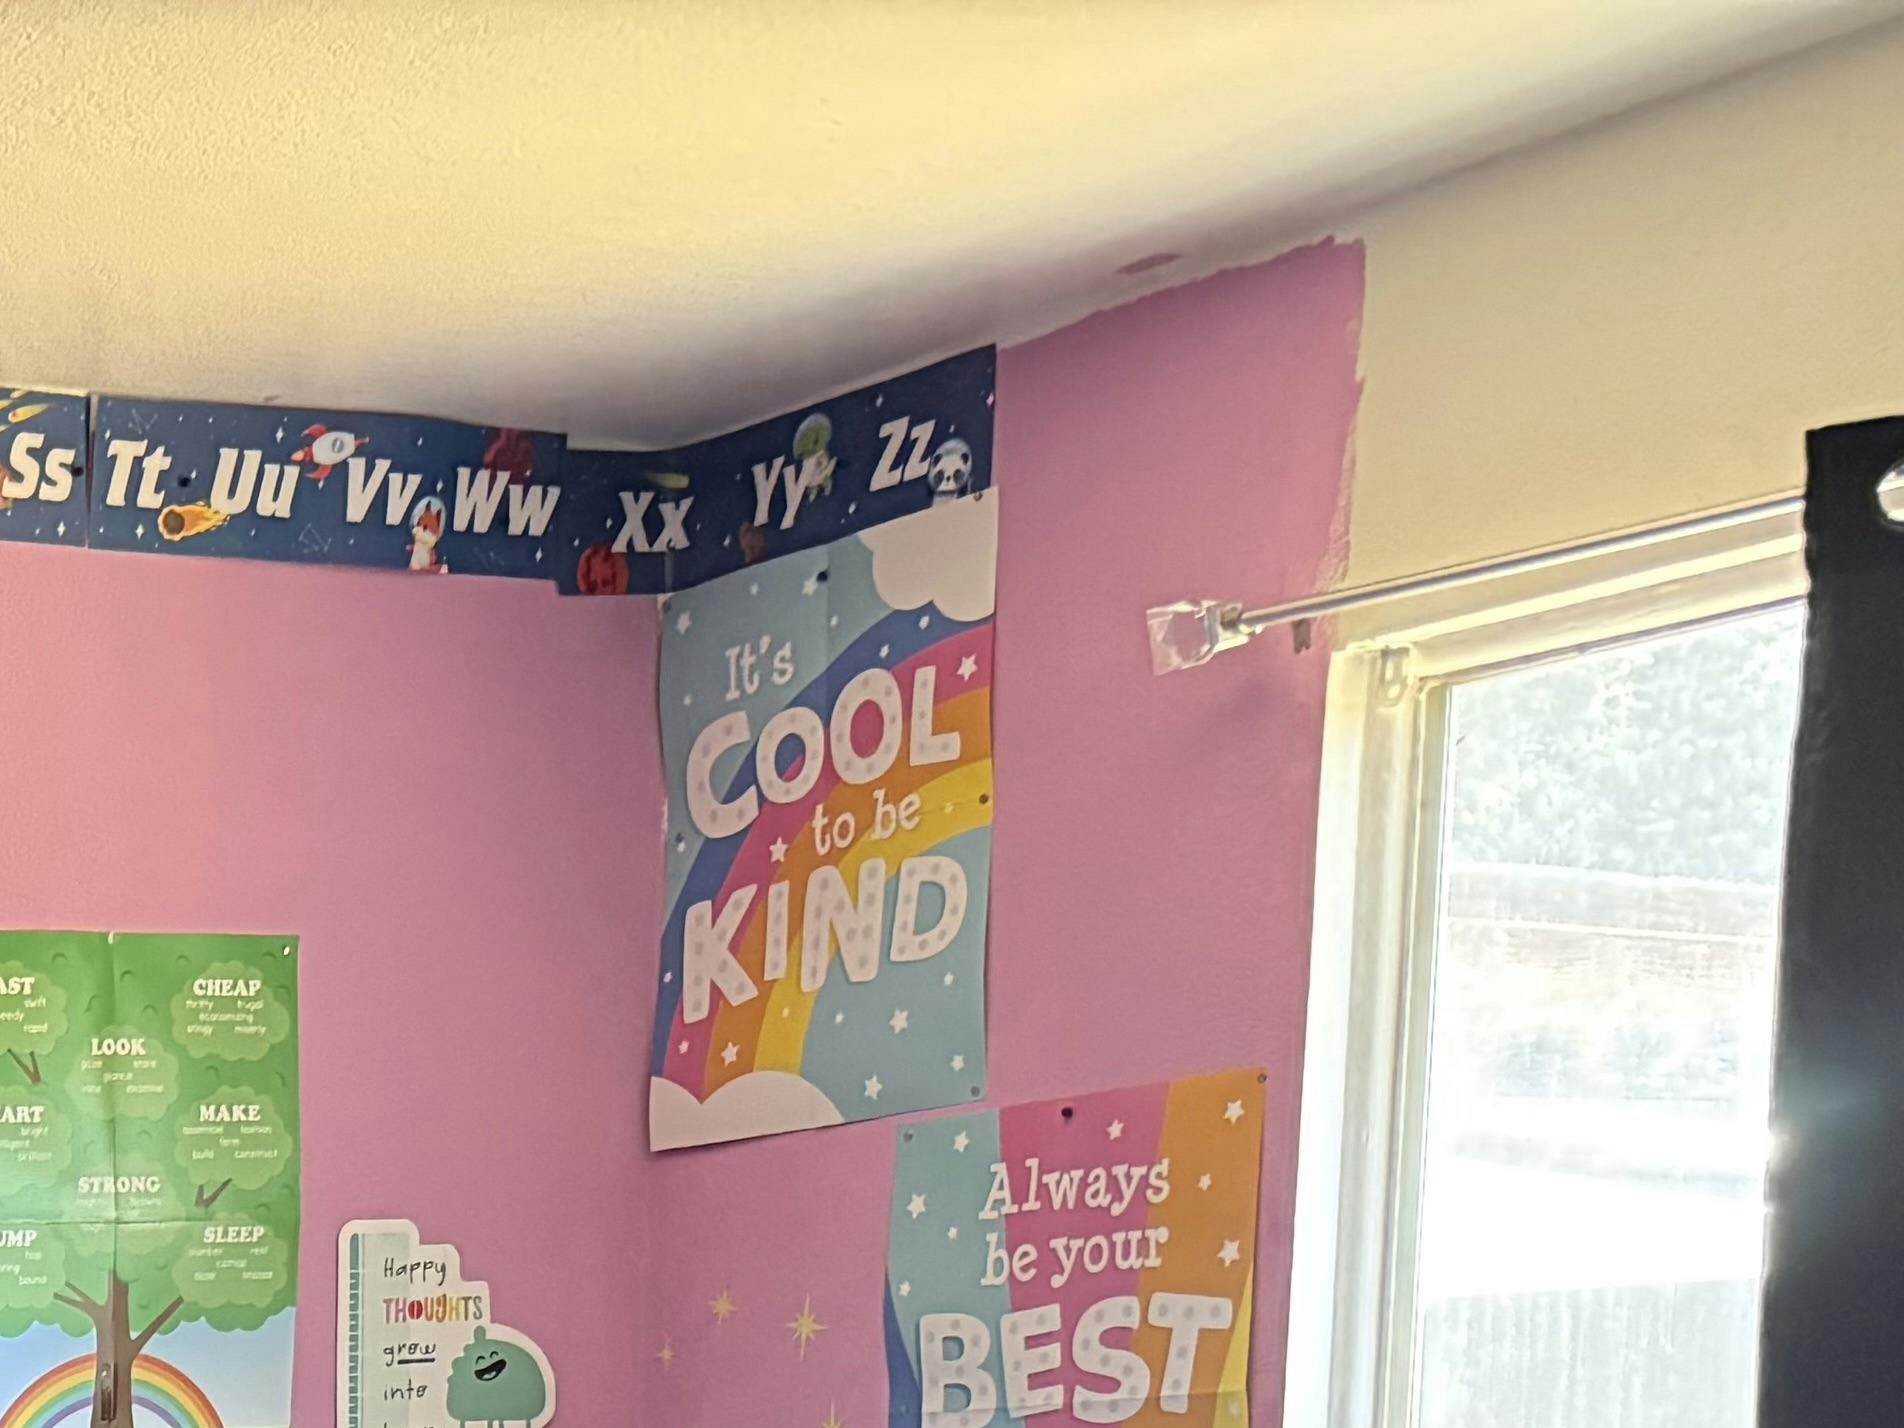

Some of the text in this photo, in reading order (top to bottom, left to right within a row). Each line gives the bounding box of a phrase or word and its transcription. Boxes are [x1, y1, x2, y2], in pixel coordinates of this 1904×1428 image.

[1, 432, 75, 501] Ss
[105, 440, 167, 508] Tt
[210, 449, 300, 518] Uu
[346, 457, 421, 526] Vv
[453, 468, 560, 537] Ww
[612, 491, 693, 552] Xx
[751, 455, 813, 529] Yy
[869, 416, 937, 492] Zz
[725, 634, 794, 702] It's
[686, 665, 961, 839] COOL
[812, 789, 922, 856] to be
[682, 856, 967, 1024] KIND
[193, 979, 261, 996] CHEAP
[91, 1039, 146, 1056] LOOK
[199, 1105, 261, 1121] MAKE
[78, 1177, 160, 1193] STRONG
[978, 1157, 1171, 1221] Always
[203, 1227, 264, 1243] SLEEP
[384, 1257, 446, 1286] Happy
[980, 1225, 1169, 1289] be your
[382, 1295, 483, 1324] THOUGHTS
[383, 1342, 436, 1366] grow
[384, 1379, 427, 1401] into
